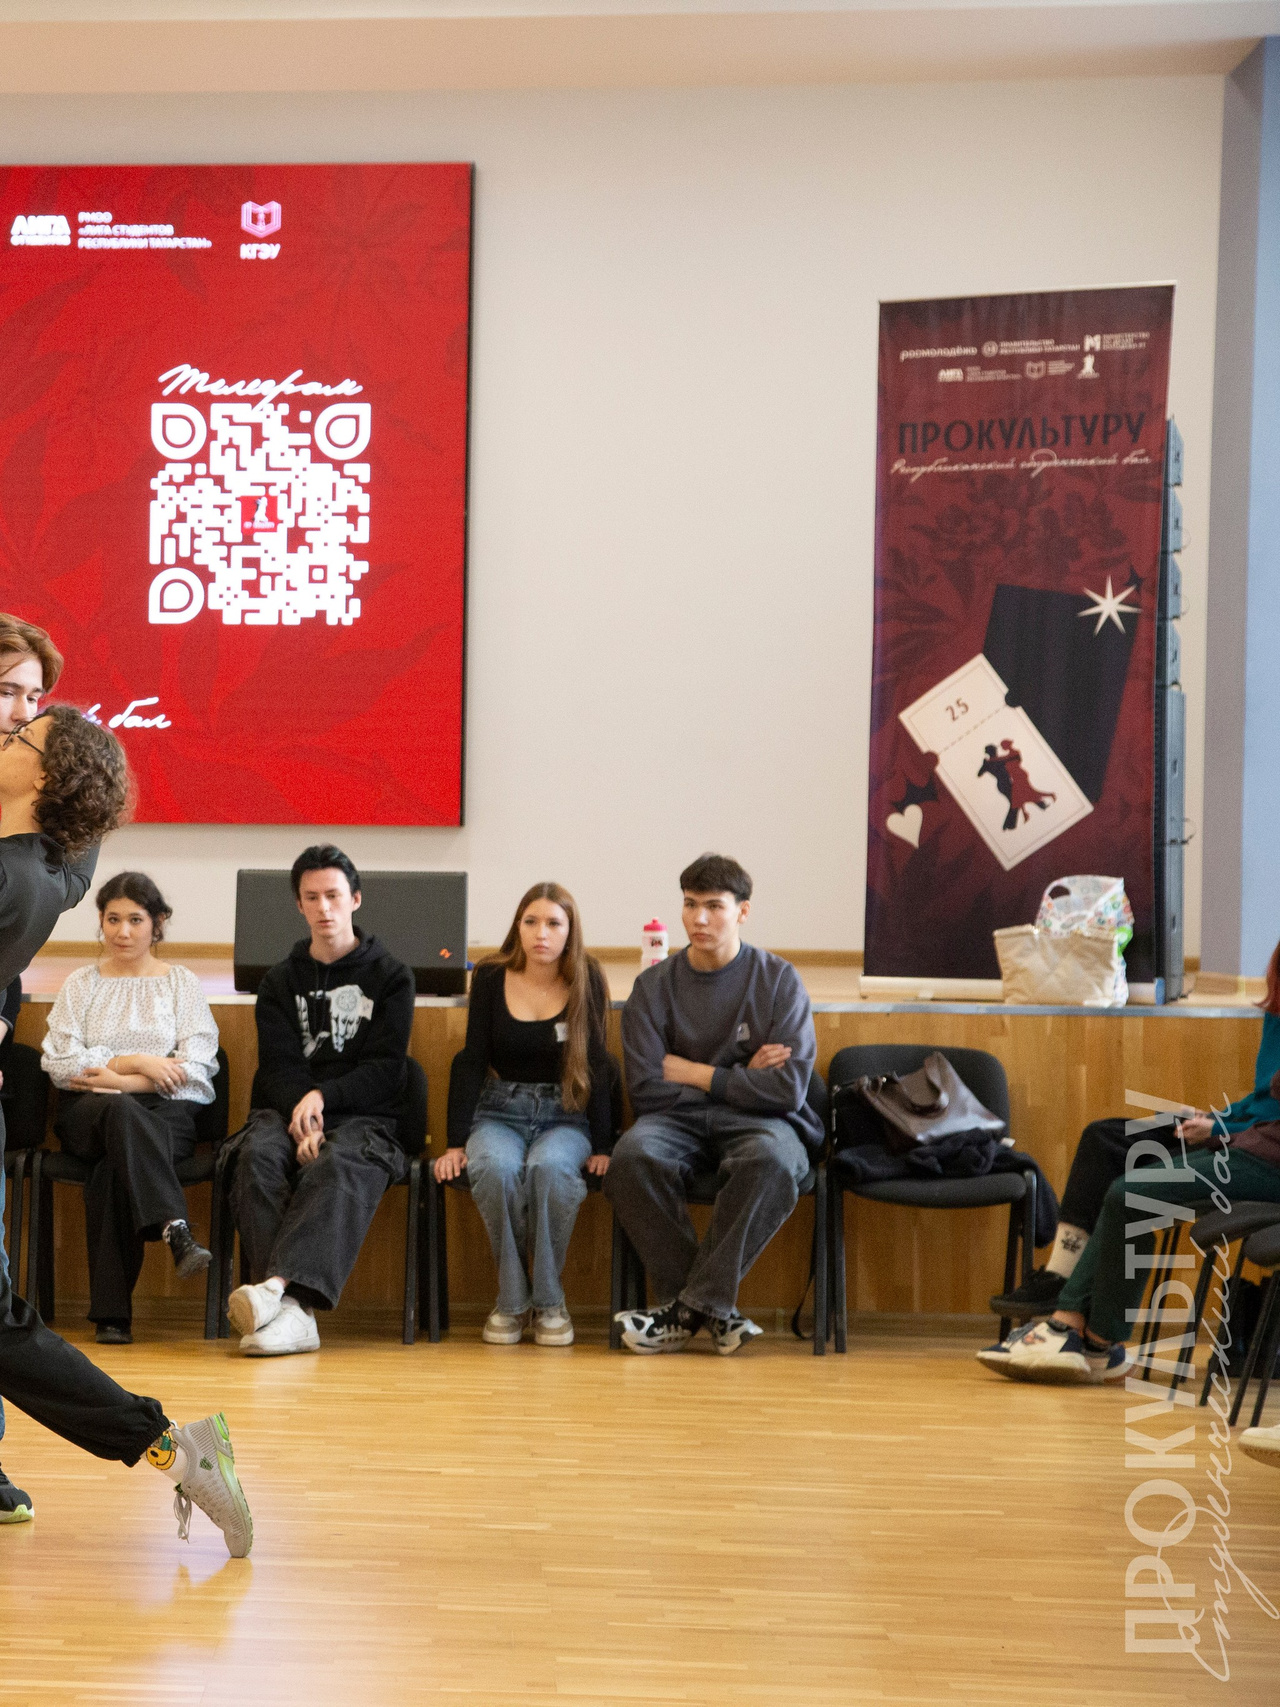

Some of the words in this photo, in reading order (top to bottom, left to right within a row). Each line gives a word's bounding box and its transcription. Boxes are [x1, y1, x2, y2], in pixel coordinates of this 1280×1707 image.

[898, 411, 1147, 455] ПРОКУЛЬТУРУ
[108, 696, 172, 729] бал
[946, 698, 969, 721] 25
